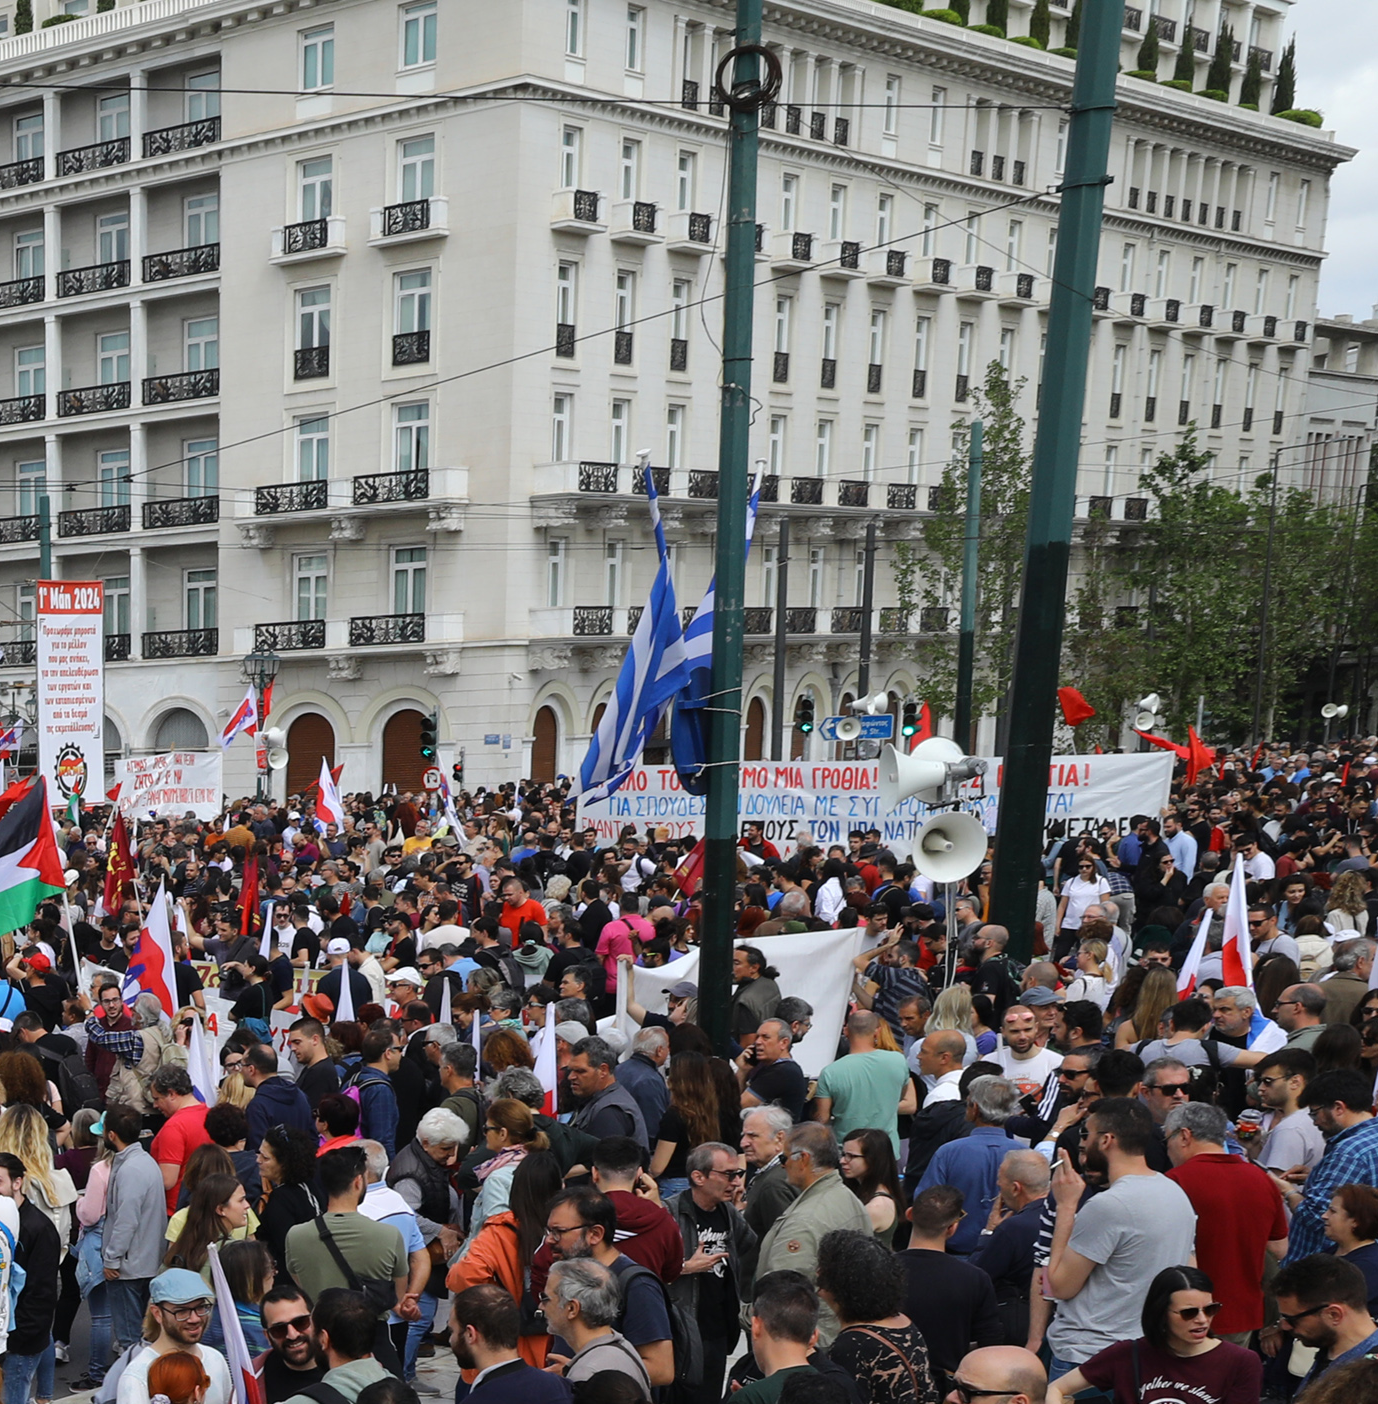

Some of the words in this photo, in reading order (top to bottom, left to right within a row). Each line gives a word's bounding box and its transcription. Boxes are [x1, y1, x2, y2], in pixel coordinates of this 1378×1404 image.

[74, 588, 100, 609] 2024
[774, 767, 804, 788] ΜΙΑ
[812, 767, 877, 790] ΓΡΟΘΙΑ!
[609, 796, 631, 815] ΓΙΑ
[636, 796, 706, 816] ΣΠΟΥΔΕΣ
[746, 794, 804, 816] ΔΟΥΛΕΙΑ
[815, 796, 838, 816] ΜΕ
[808, 820, 840, 842] ΤΩΝ
[1174, 1382, 1189, 1391] we
[1188, 1386, 1221, 1404] stand
